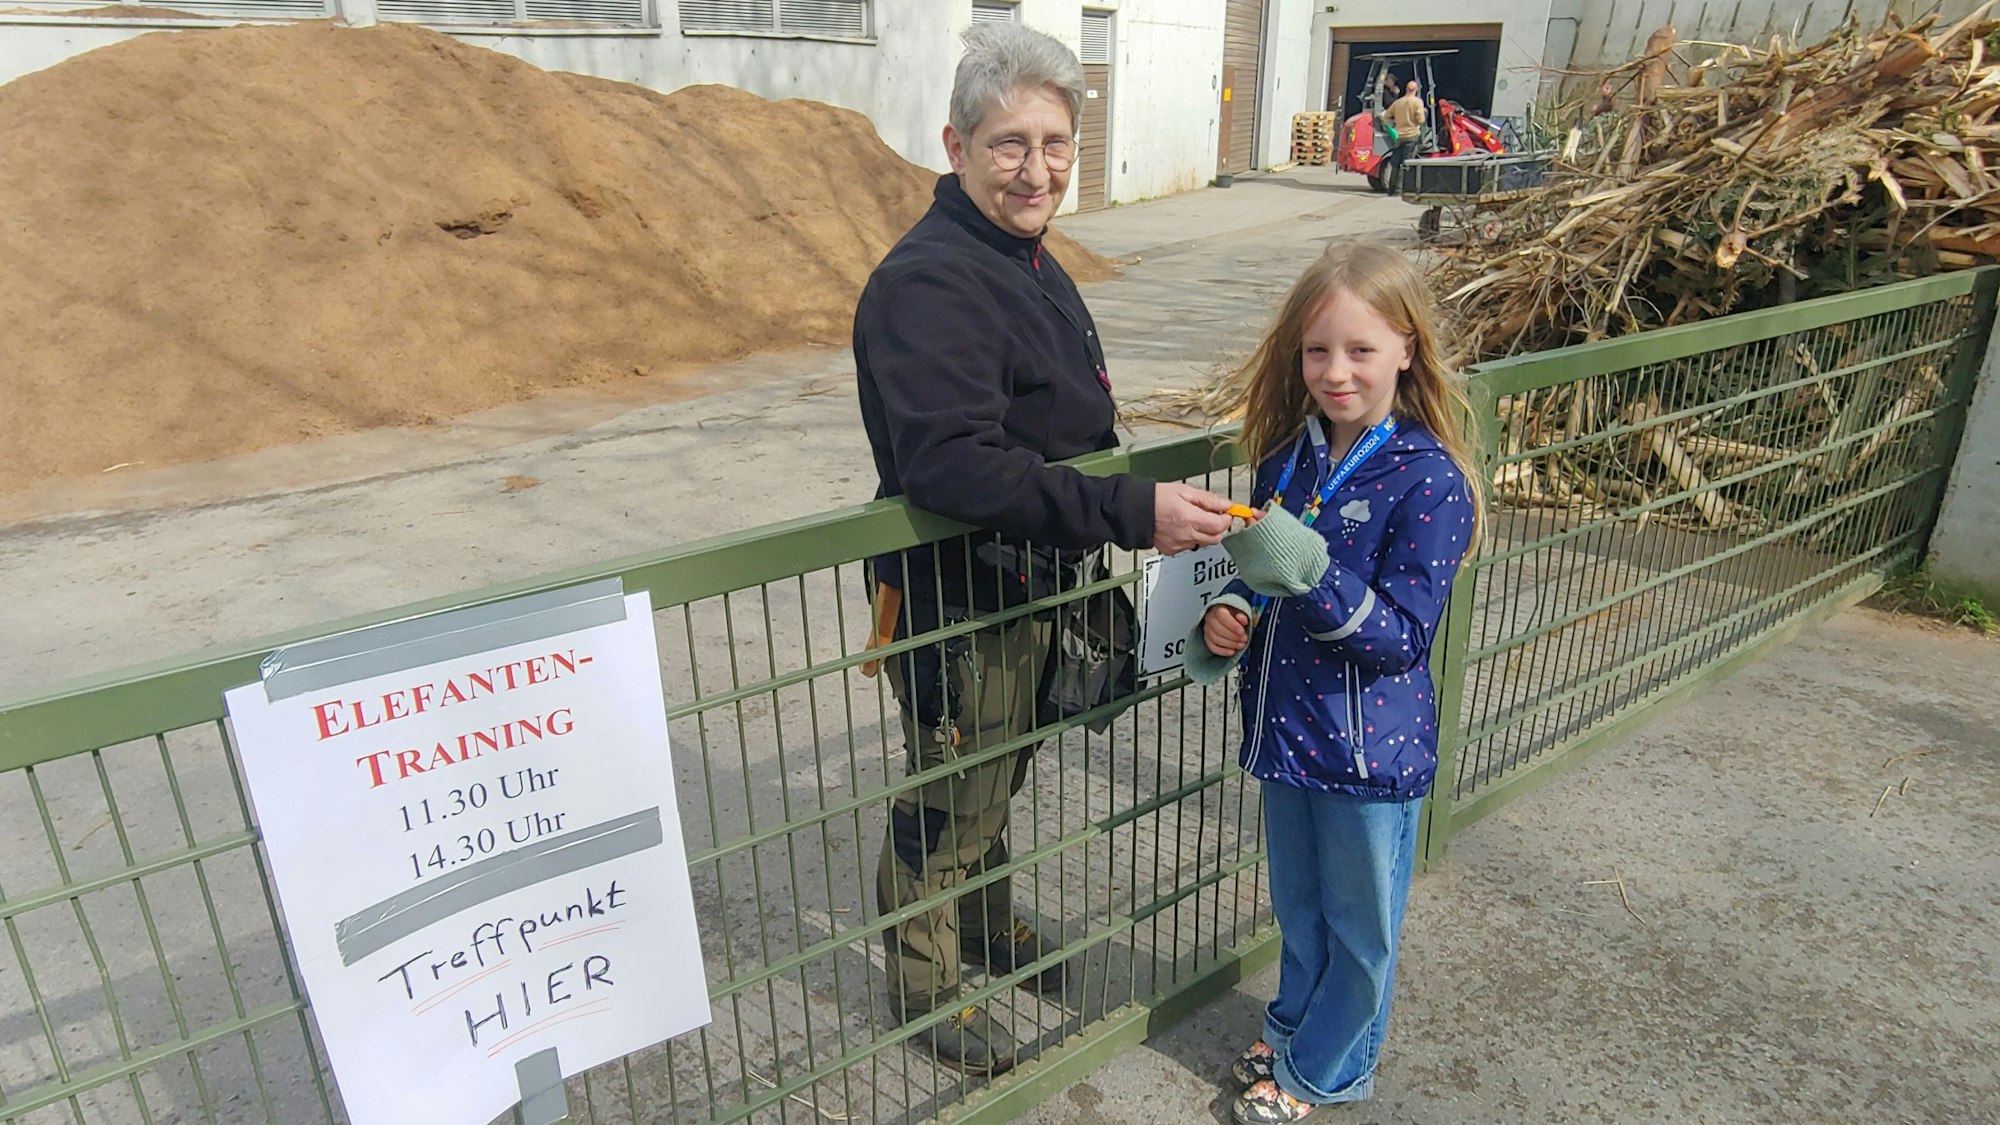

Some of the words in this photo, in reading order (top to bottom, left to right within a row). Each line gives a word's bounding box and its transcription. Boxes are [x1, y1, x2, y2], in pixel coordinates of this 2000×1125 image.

[1194, 557, 1236, 585] Bitte
[309, 649, 593, 741] ELEFANTEN-
[357, 709, 575, 789] TRAINING
[400, 782, 487, 832] 11.30
[500, 766, 560, 801] Uhr
[408, 828, 495, 879] 14.30
[506, 809, 566, 844] Uhr
[378, 881, 627, 1000] Treffpunkt
[465, 956, 614, 1047] HIER
